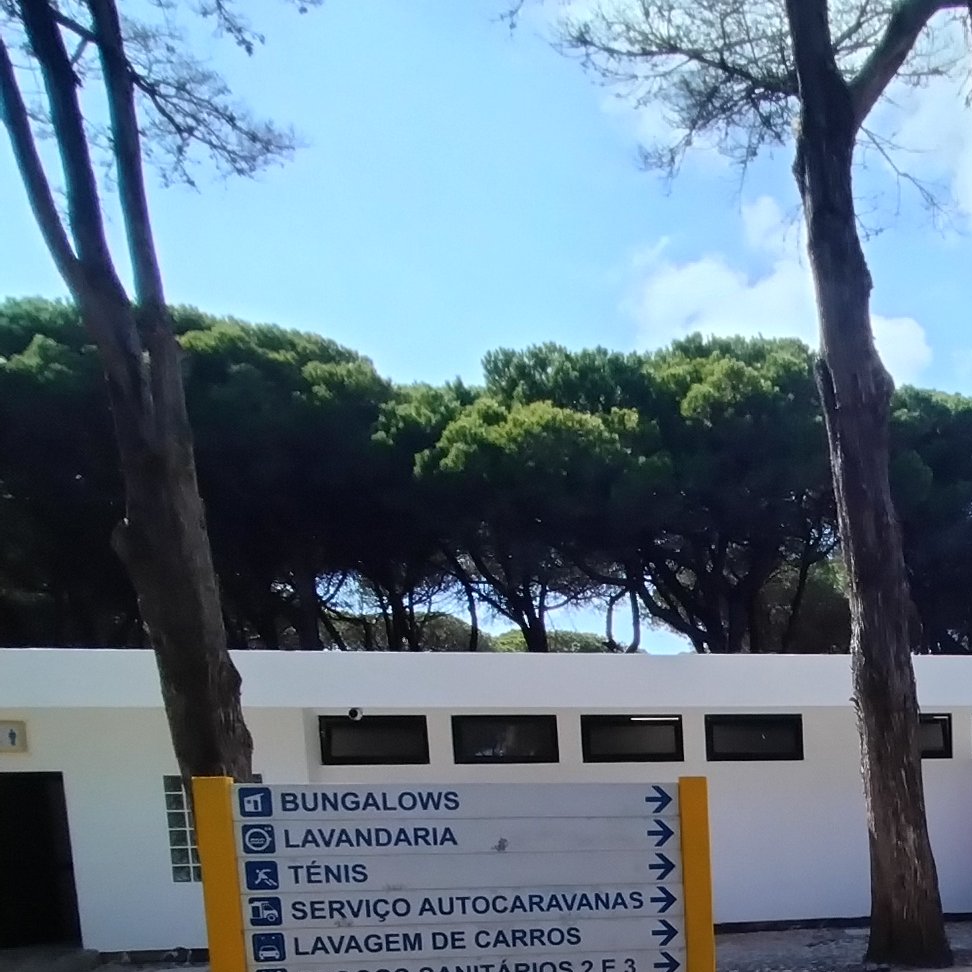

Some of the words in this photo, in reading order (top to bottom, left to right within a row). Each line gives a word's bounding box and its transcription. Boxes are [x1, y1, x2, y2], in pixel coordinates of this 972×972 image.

[280, 790, 461, 812] BUNGALOWS
[283, 826, 459, 849] LAVANDARIA
[287, 860, 369, 884] TÉNIS
[290, 898, 412, 923] SERVIÇO
[418, 890, 645, 917] AUTOCARAVANAS
[293, 932, 423, 956] LAVAGEM
[431, 931, 467, 951] DE
[474, 926, 582, 949] CARROS
